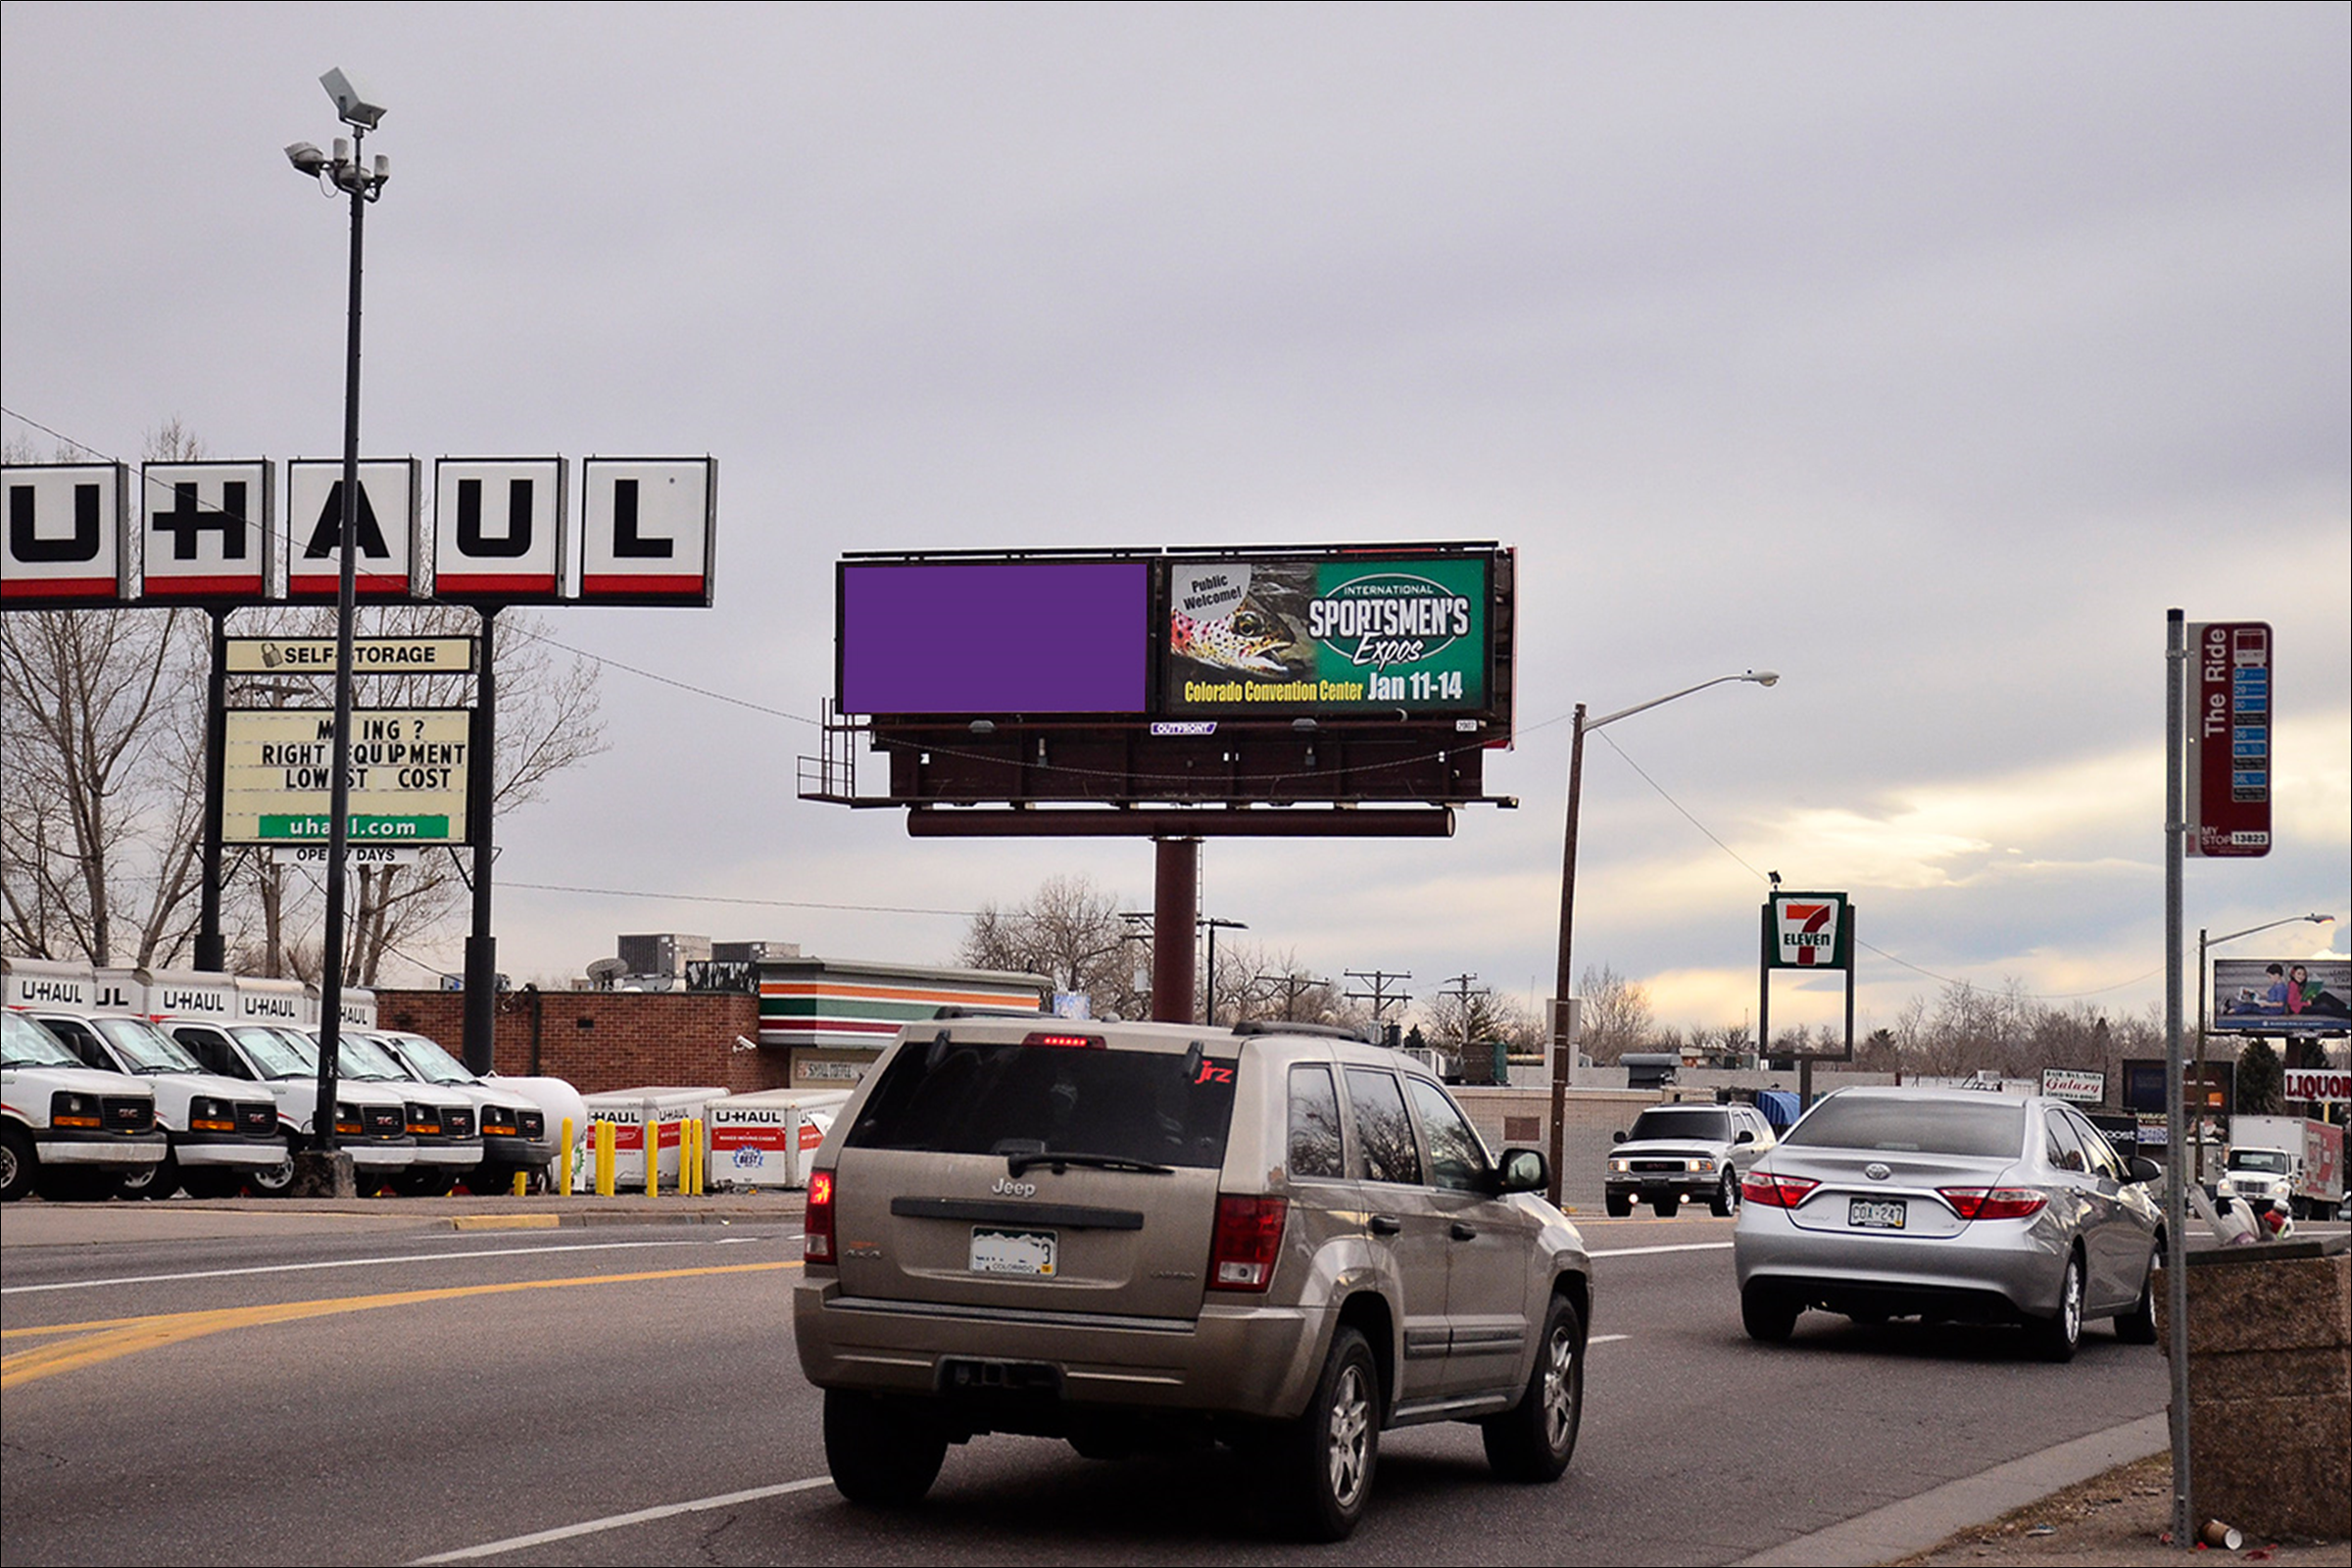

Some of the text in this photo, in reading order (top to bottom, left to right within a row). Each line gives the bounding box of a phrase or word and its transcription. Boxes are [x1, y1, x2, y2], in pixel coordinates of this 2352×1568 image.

[1192, 574, 1228, 593] Public
[1344, 585, 1433, 595] INTERNATIONAL
[1184, 586, 1242, 611] Welcome!
[1309, 598, 1468, 637] SPORTSMEN'S
[284, 647, 436, 663] SELF-TORAGE
[1352, 632, 1424, 671] Expos
[1185, 671, 1462, 702] Colorado Convention Center Jan 11-14
[2205, 628, 2226, 738] The Ride
[317, 720, 401, 740] MING
[263, 745, 466, 764] RIGHT QUIPMENT
[286, 768, 452, 789] LOWST COST
[290, 817, 416, 836] uhal.com
[2202, 834, 2266, 845] STOP 13823
[296, 850, 331, 861] OPE
[357, 850, 395, 861] DAYS
[2046, 1078, 2099, 1093] Galaxy
[992, 1178, 1036, 1198] Jeep
